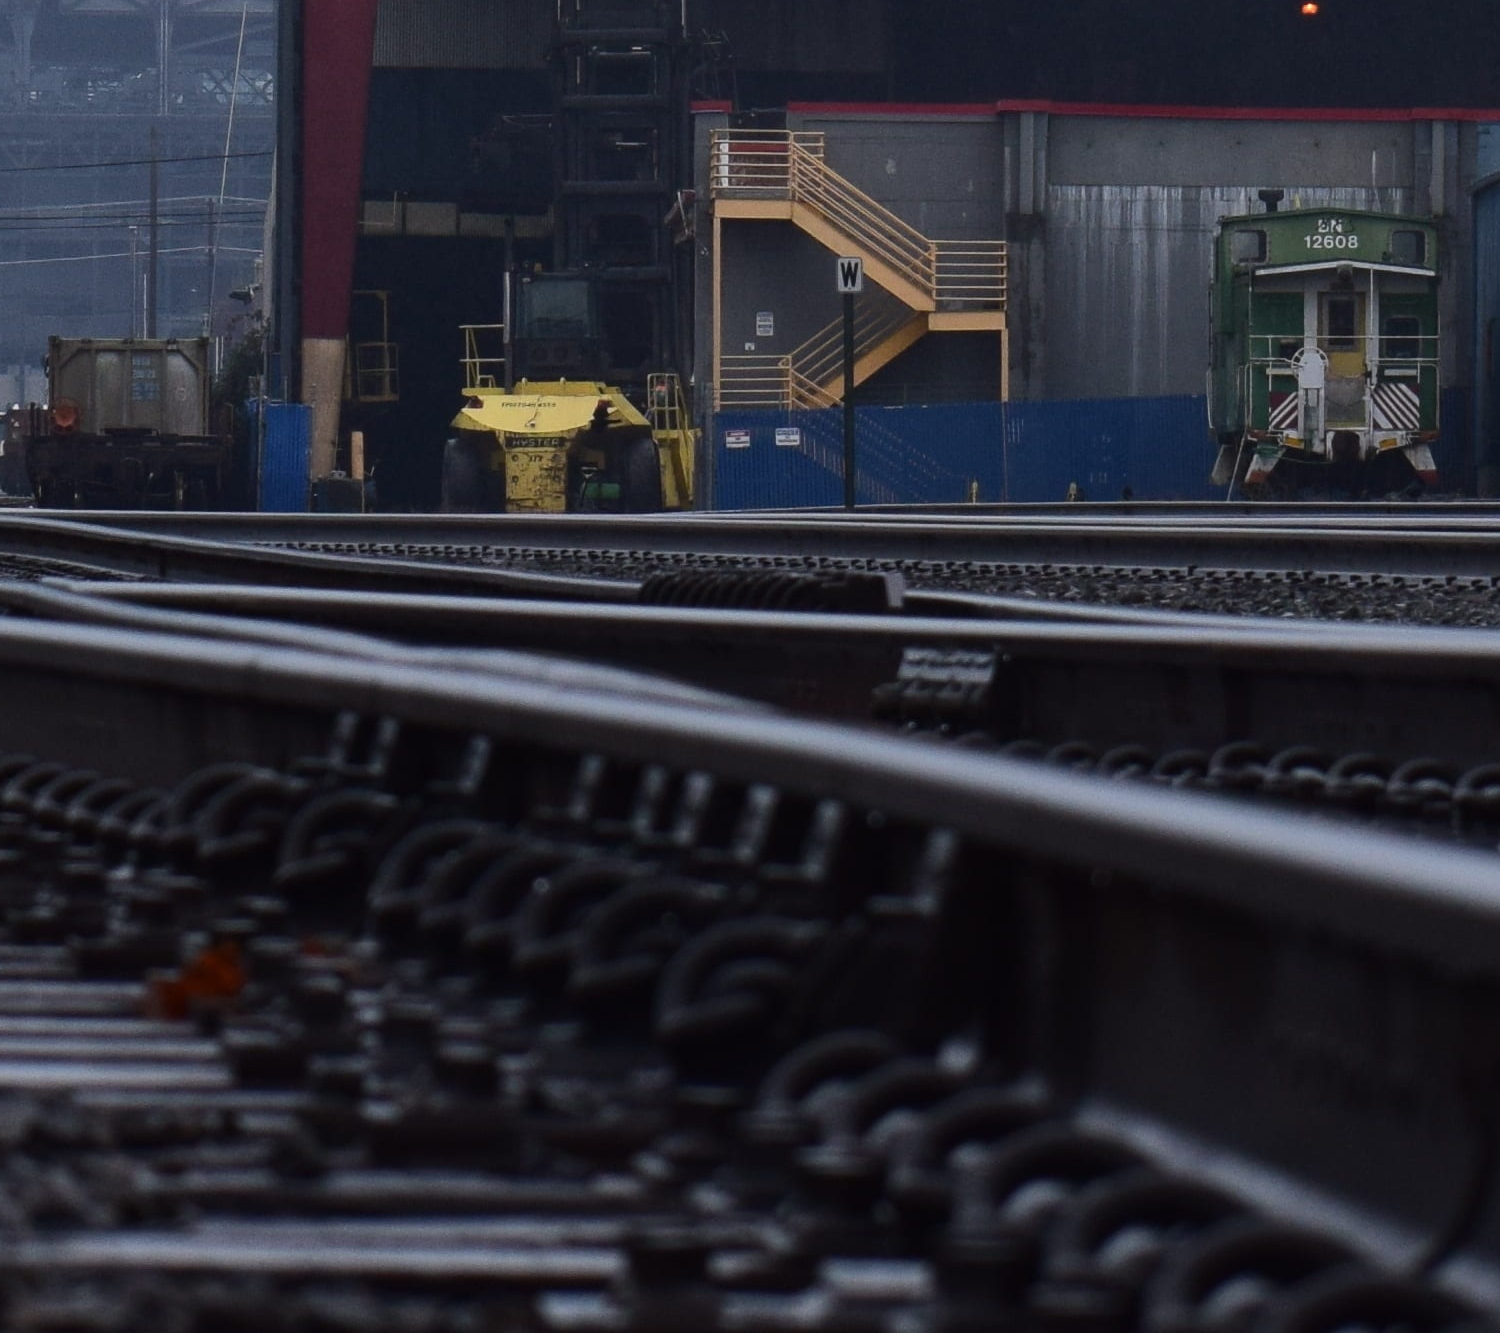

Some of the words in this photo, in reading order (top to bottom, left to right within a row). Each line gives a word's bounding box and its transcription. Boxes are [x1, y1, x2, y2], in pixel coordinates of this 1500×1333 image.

[1304, 235, 1358, 249] 12608
[841, 261, 859, 287] W
[512, 437, 560, 447] HYSTER
